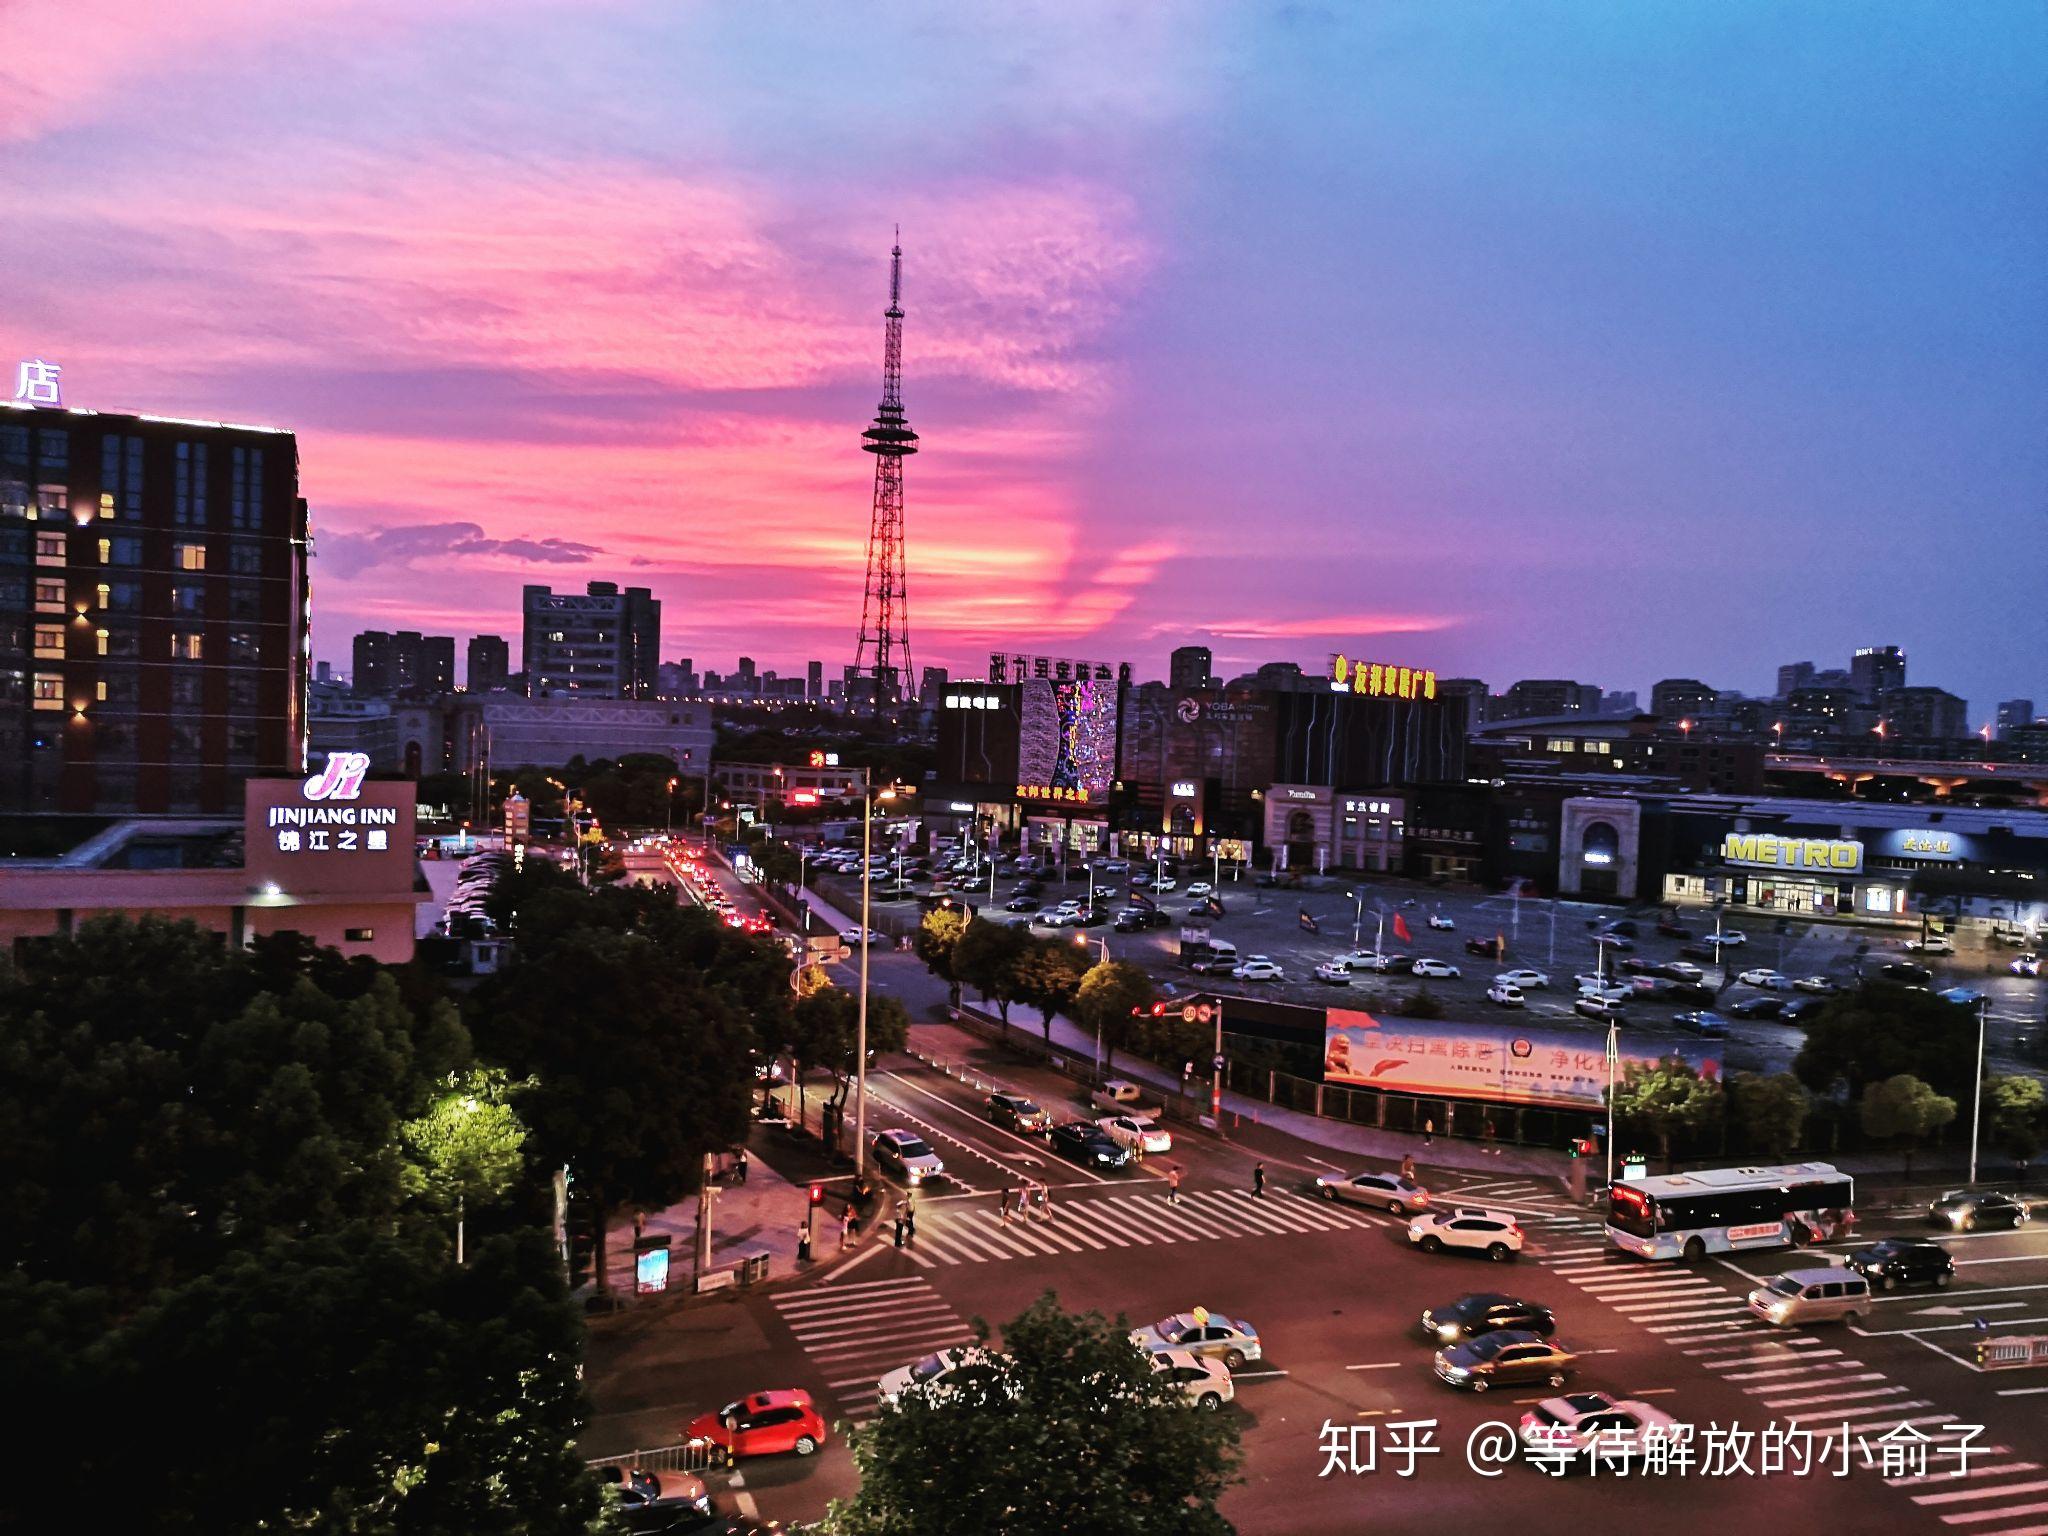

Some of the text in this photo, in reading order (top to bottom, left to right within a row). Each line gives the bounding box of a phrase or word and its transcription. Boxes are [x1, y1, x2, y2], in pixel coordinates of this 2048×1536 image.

[16, 359, 62, 402] 店
[269, 807, 396, 827] JINJIANG INN
[278, 829, 388, 851] 锦江之星
[1727, 836, 1858, 869] METRO
